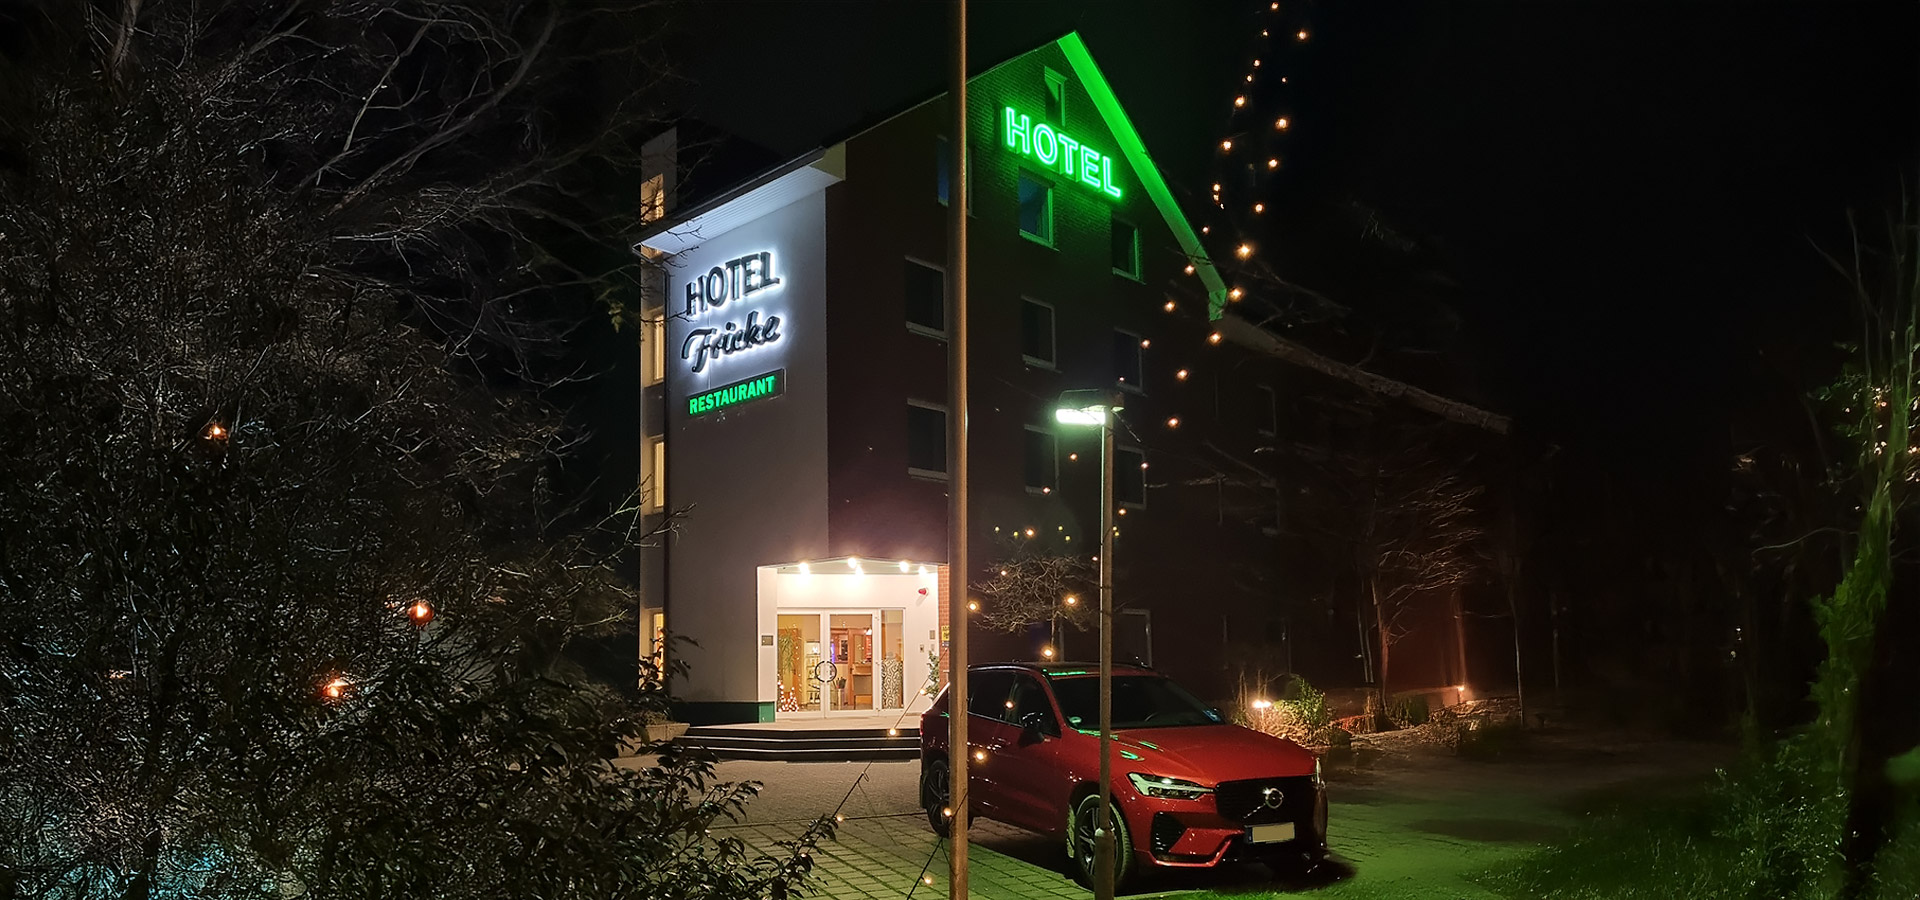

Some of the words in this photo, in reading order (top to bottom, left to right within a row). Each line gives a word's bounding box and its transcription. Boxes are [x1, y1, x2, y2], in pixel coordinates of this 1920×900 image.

[1005, 106, 1121, 198] HOTEL
[685, 251, 780, 316] HOTEL
[681, 311, 781, 373] Fricke
[689, 375, 775, 415] RESTAURANT
